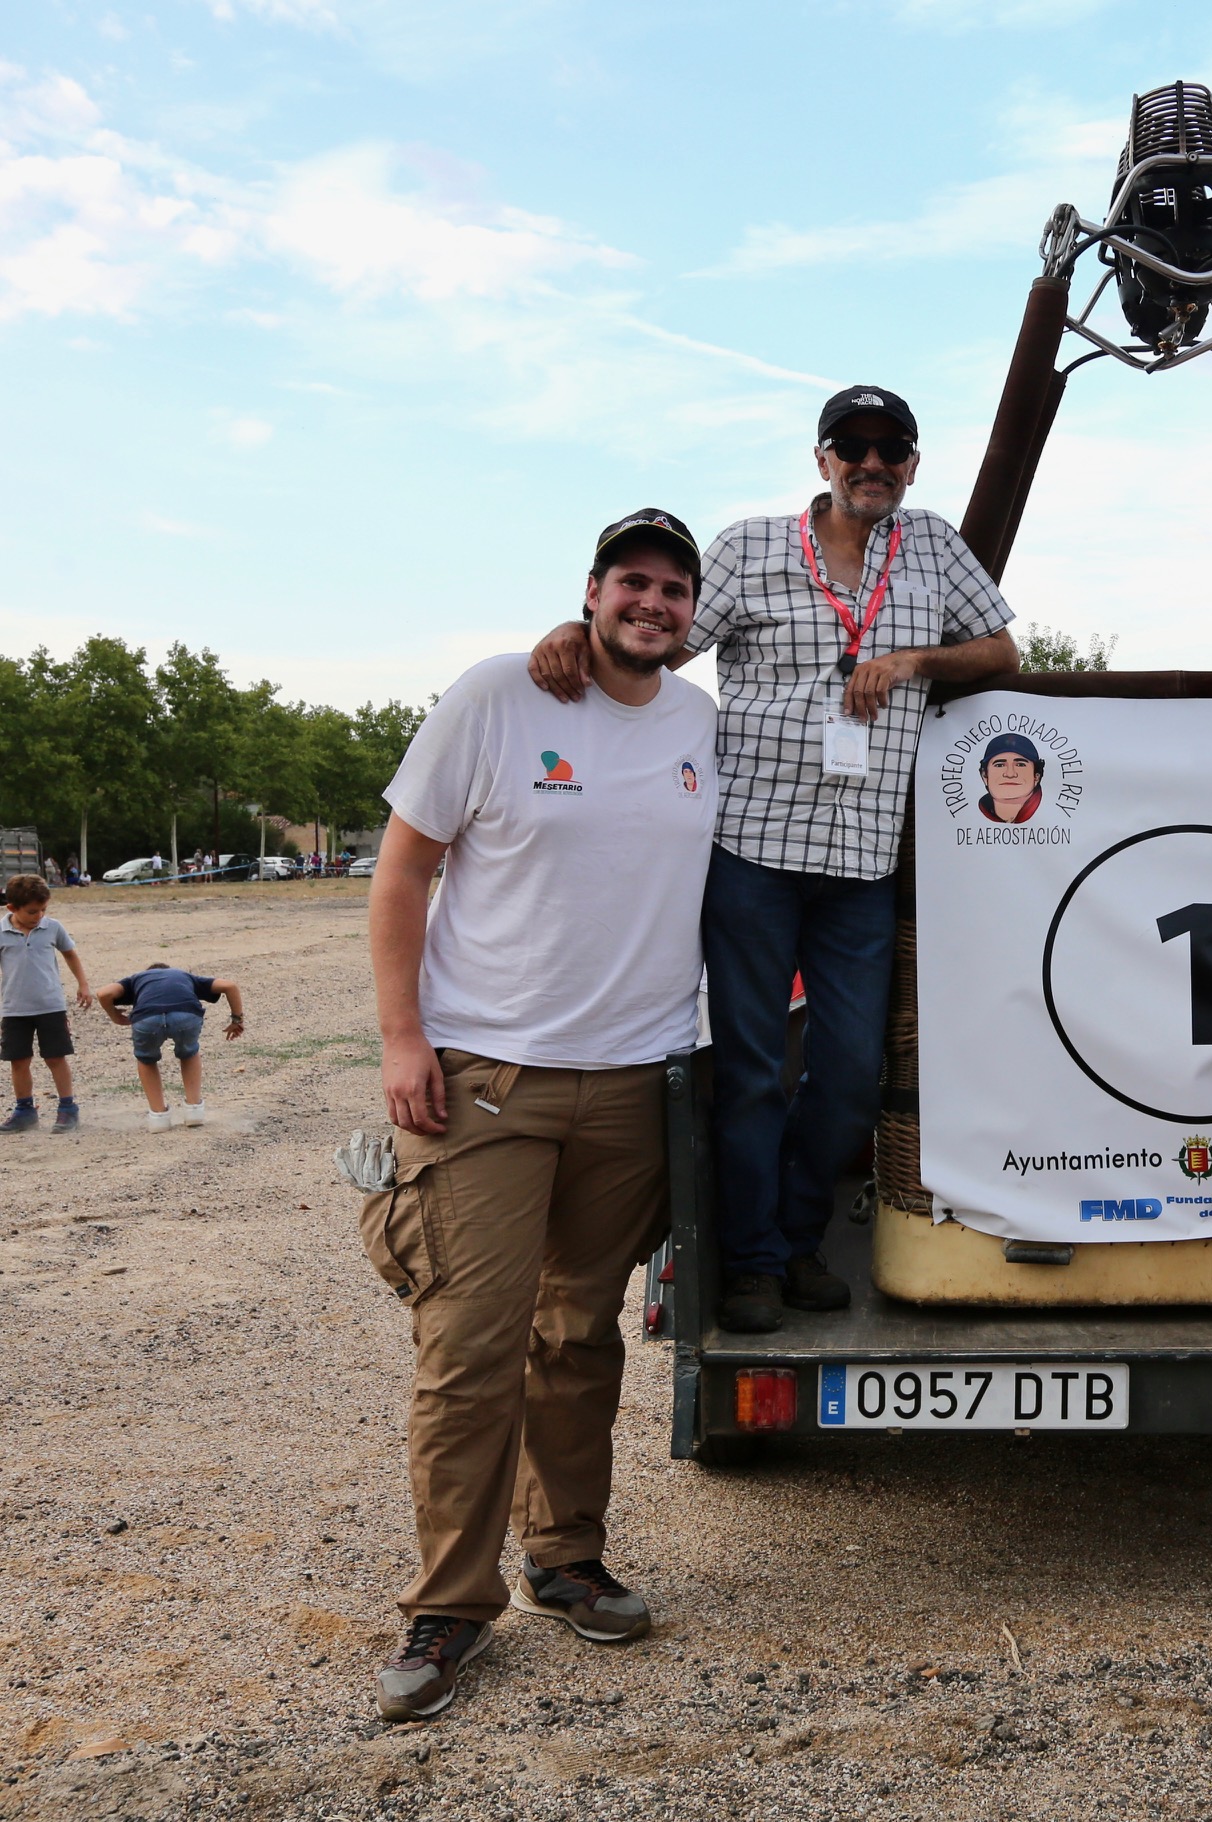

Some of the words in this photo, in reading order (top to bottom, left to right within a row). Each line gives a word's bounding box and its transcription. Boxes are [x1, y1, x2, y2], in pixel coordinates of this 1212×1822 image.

[954, 714, 1002, 754] DIEGO
[1007, 713, 1069, 751] CRIADO
[830, 759, 863, 771] Participante
[1057, 748, 1083, 779] DEL
[532, 781, 583, 792] MESETARIO
[942, 753, 969, 819] TROFEO
[1055, 783, 1083, 819] REY
[957, 828, 973, 845] DE
[976, 825, 1071, 845] AEROSTACIÓN
[1002, 1146, 1163, 1176] Ayuntamiento
[1079, 1198, 1163, 1222] FMD
[828, 1401, 839, 1415] E
[857, 1371, 993, 1420] 0957
[1014, 1372, 1114, 1420] DTB
